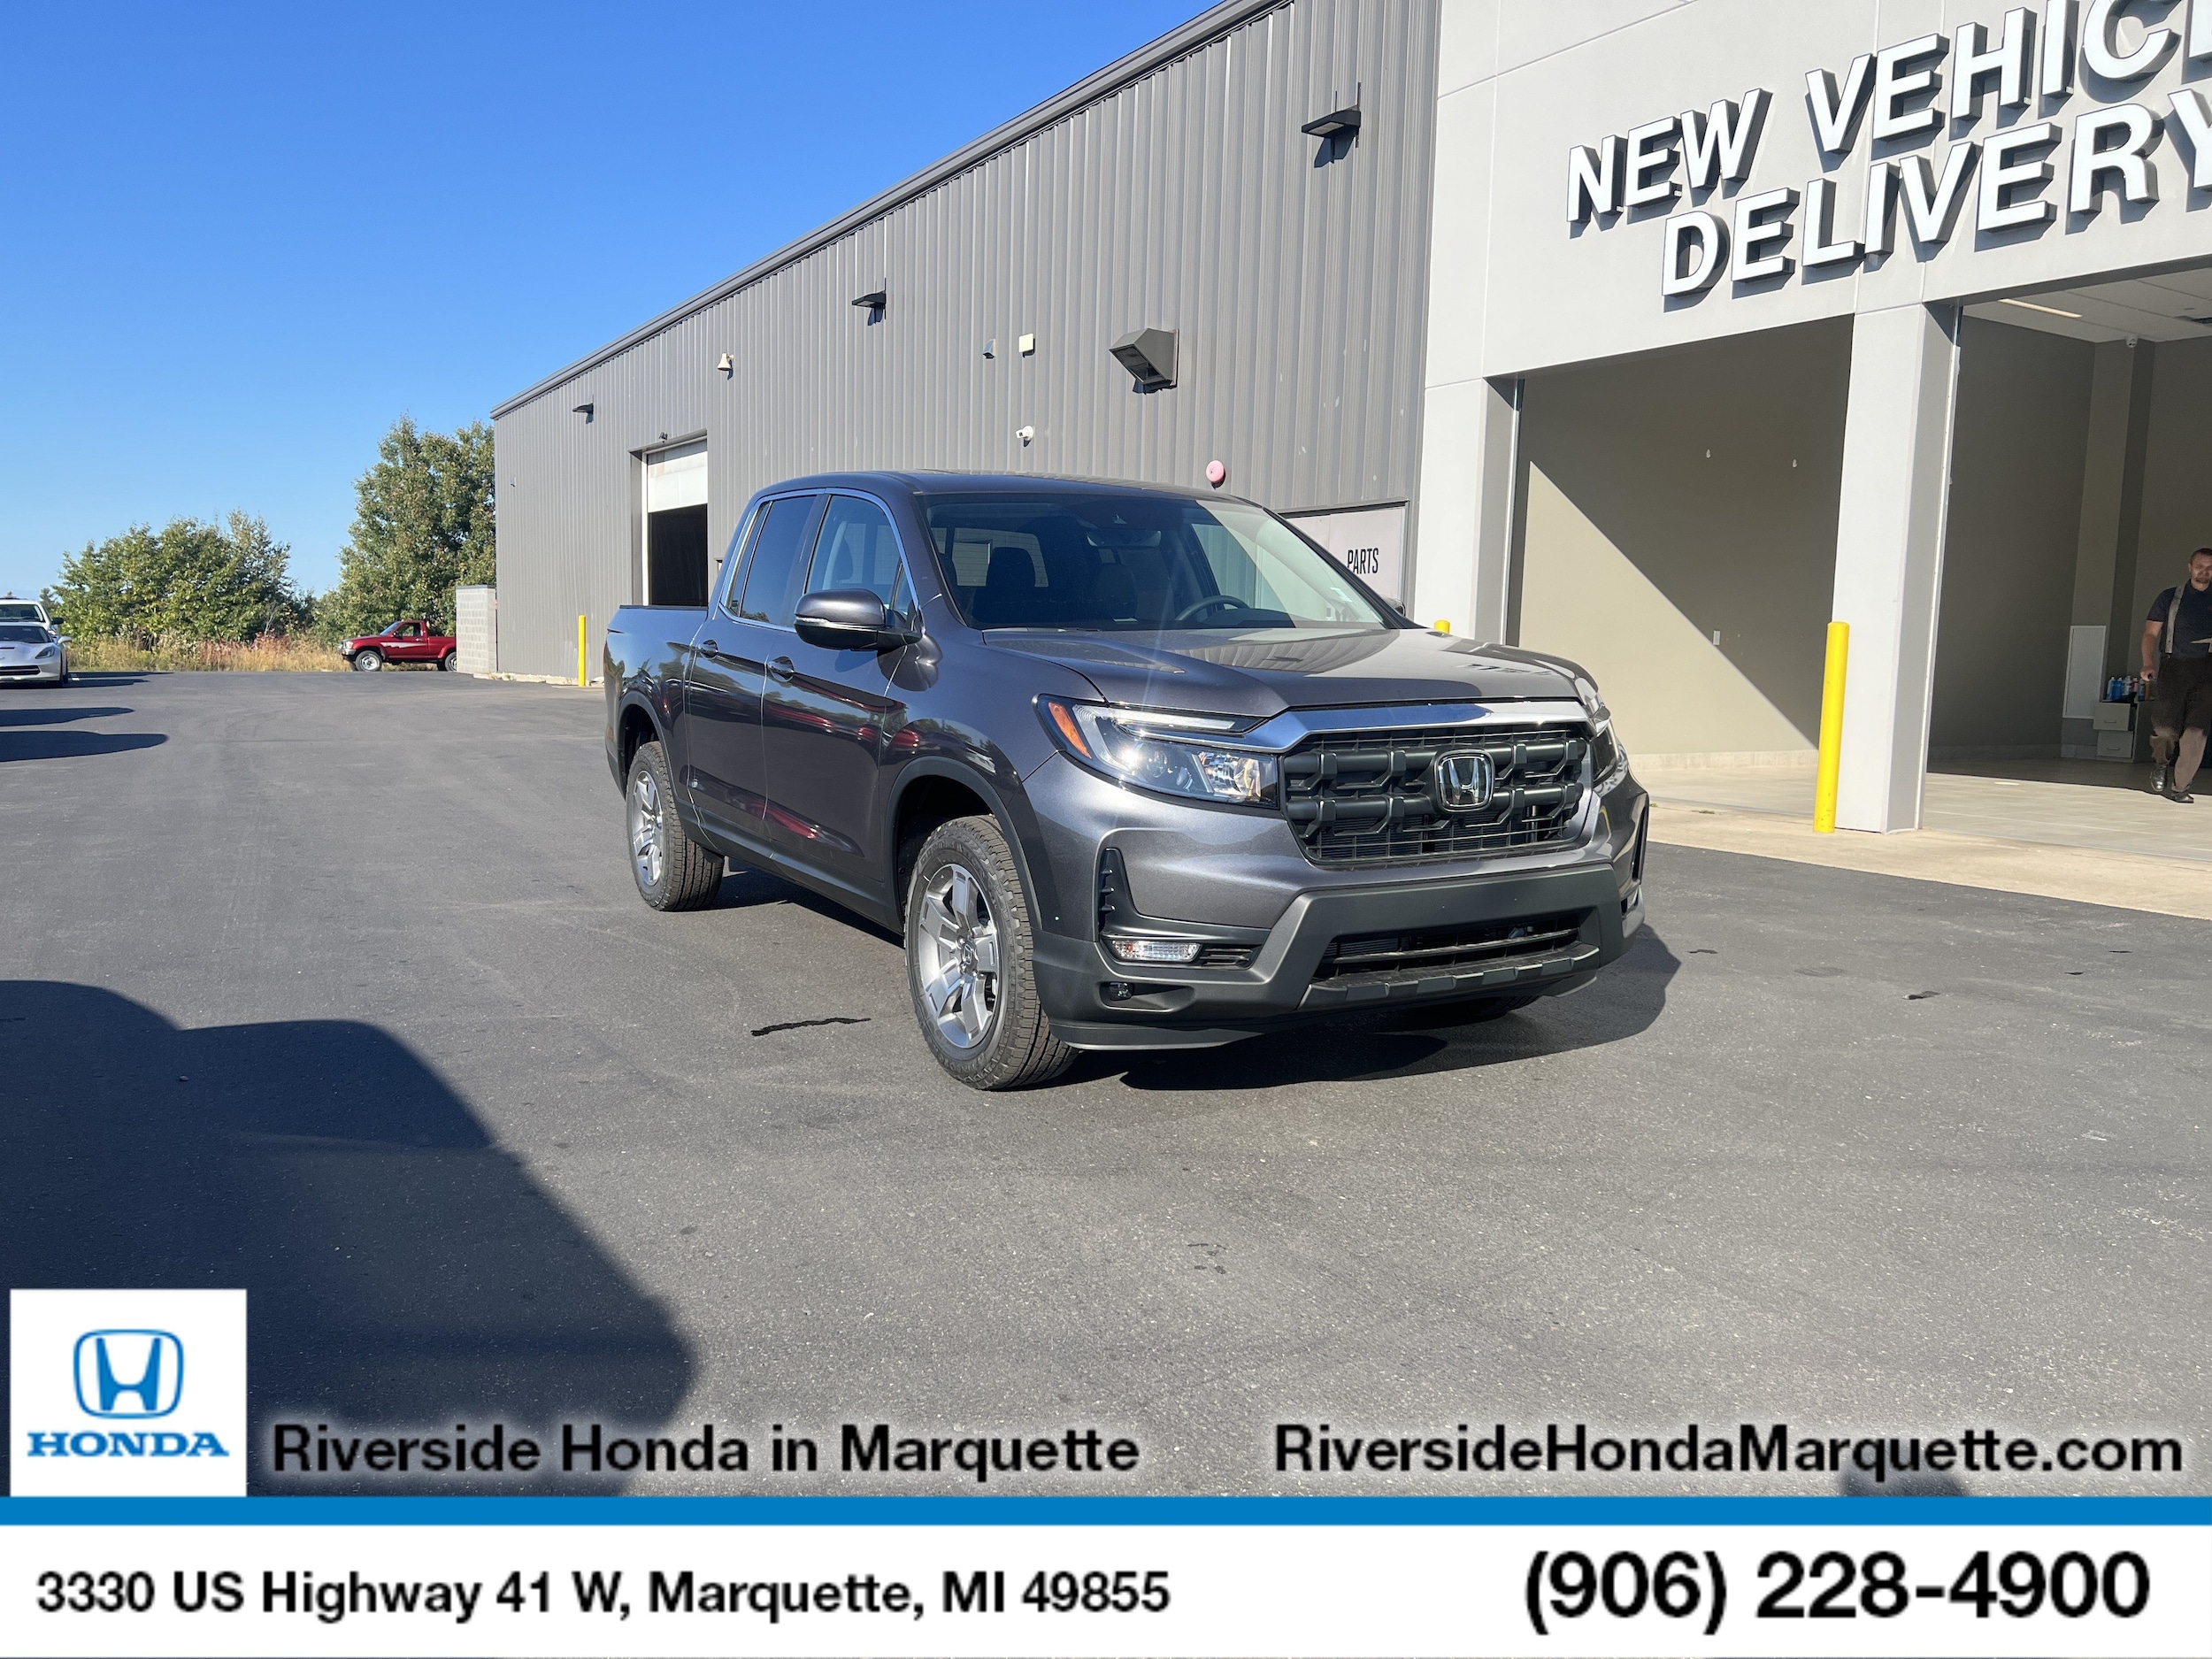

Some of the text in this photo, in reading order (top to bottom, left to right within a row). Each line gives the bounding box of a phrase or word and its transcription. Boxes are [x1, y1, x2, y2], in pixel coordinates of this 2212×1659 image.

[1566, 0, 2212, 224] NEW VEHIC
[1347, 547, 1379, 574] PARTS
